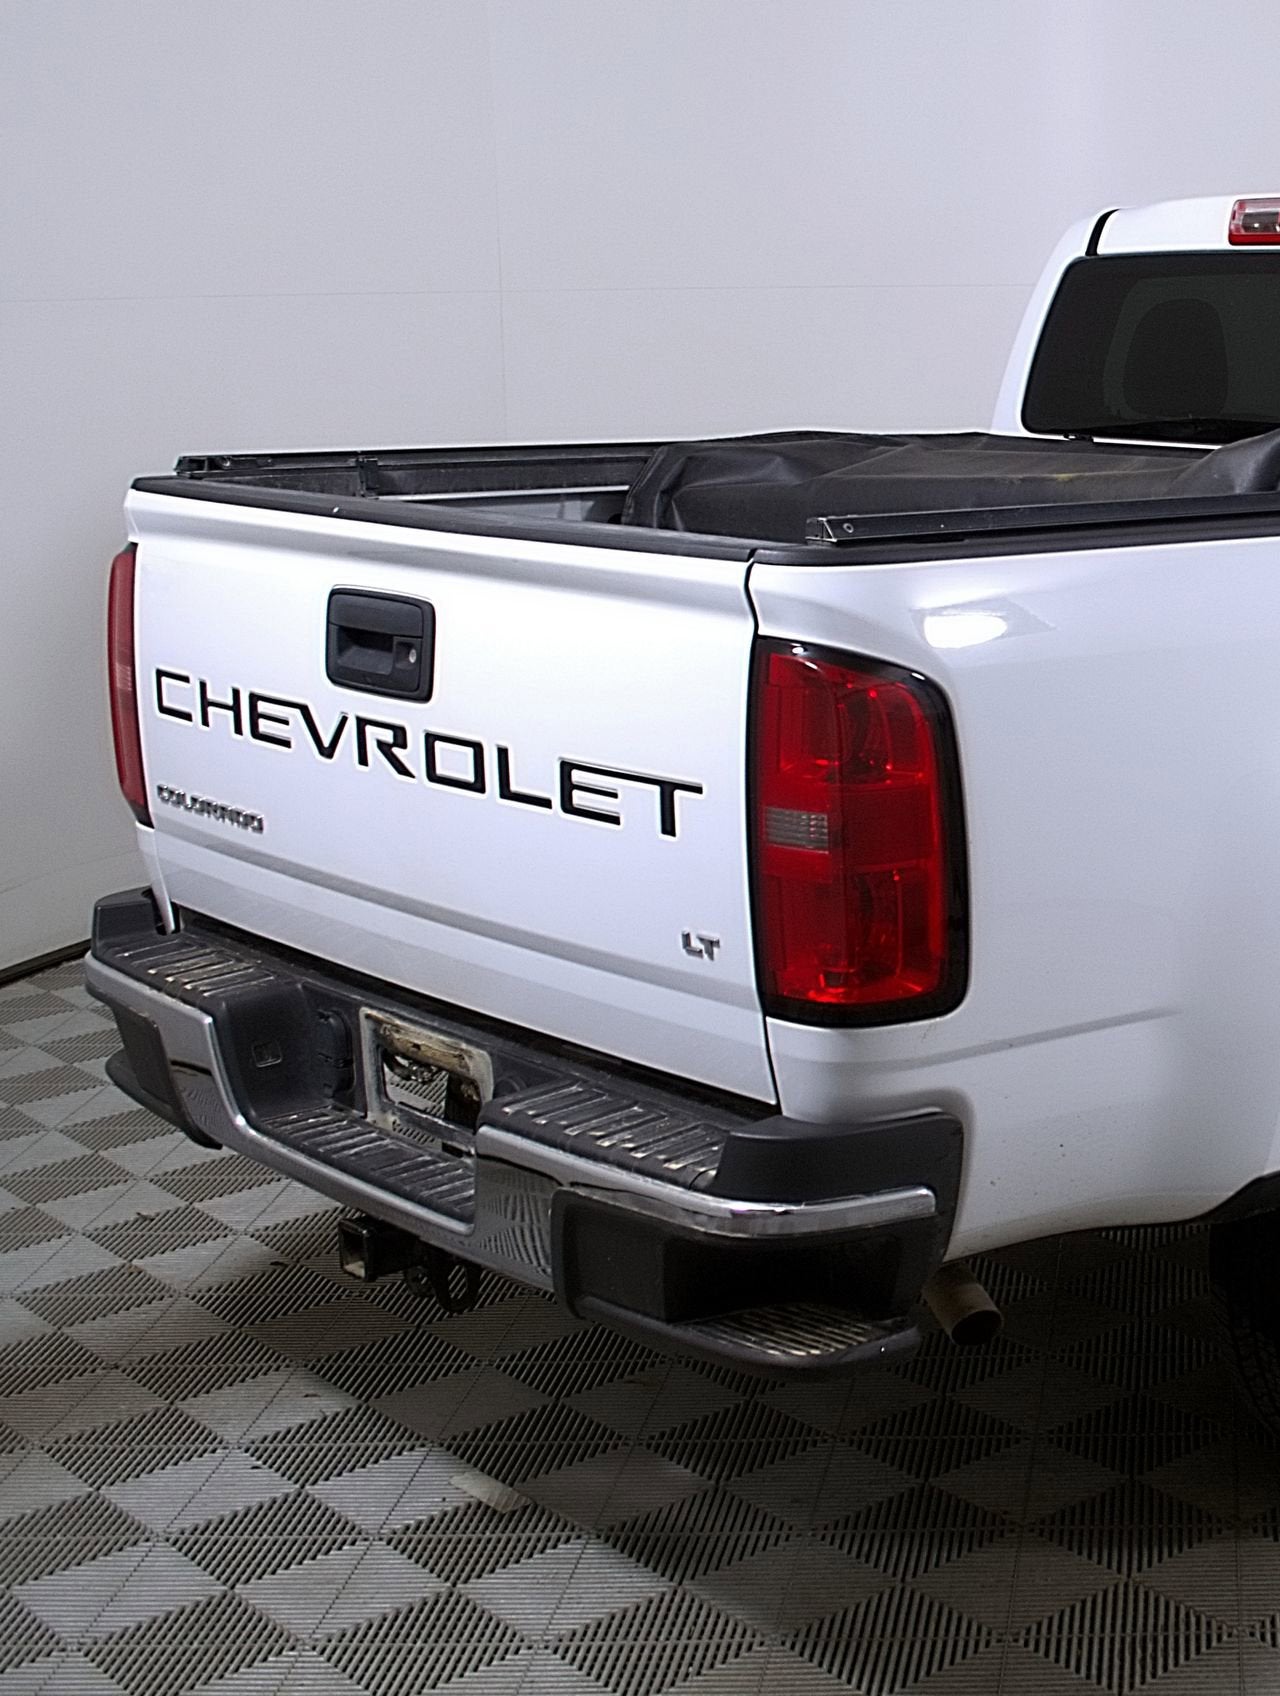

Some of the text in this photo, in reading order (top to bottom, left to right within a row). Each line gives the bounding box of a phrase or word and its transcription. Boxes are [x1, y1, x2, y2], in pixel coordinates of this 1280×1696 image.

[155, 667, 703, 837] CHEVROLET
[157, 784, 264, 834] COLORADO
[681, 931, 720, 961] LT
